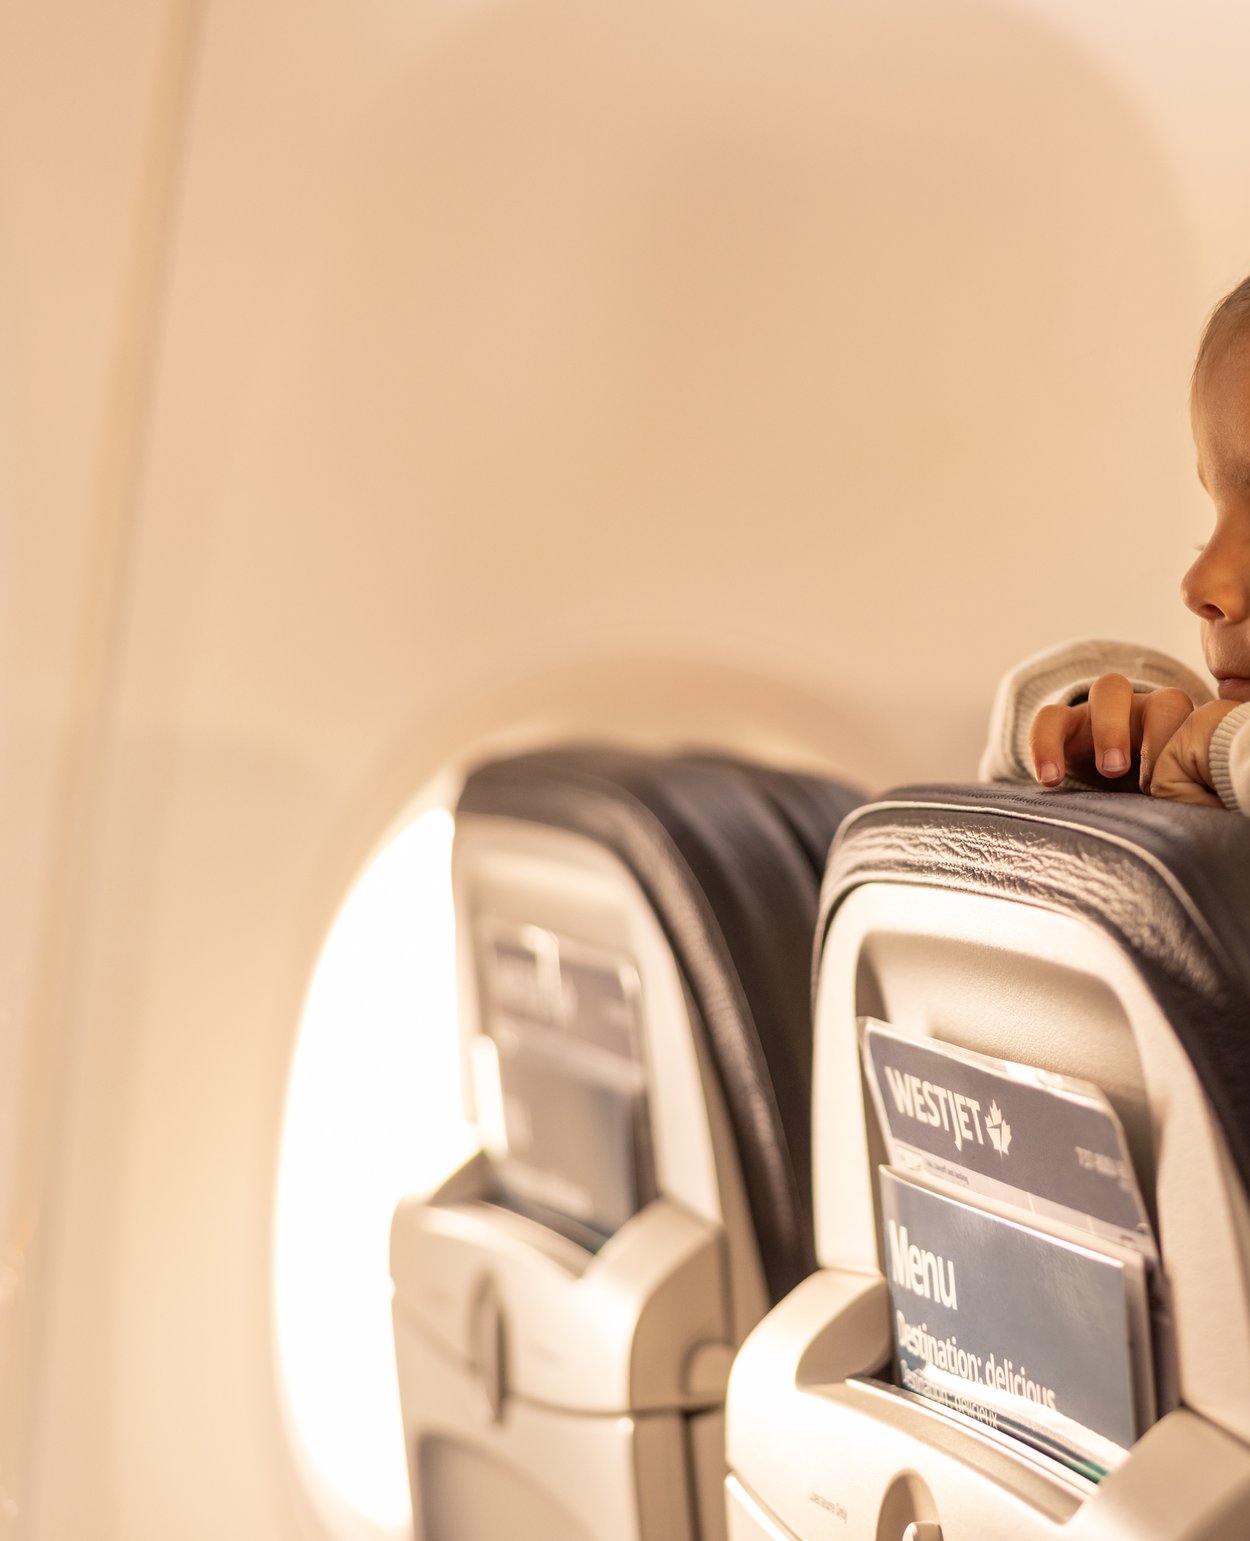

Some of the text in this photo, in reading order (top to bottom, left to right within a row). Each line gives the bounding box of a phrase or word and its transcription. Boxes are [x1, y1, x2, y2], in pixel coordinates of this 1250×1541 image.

[885, 1066, 984, 1152] WESTJET
[889, 1219, 958, 1311] Menu
[896, 1309, 984, 1386] Destination:
[985, 1353, 1057, 1411] delicious
